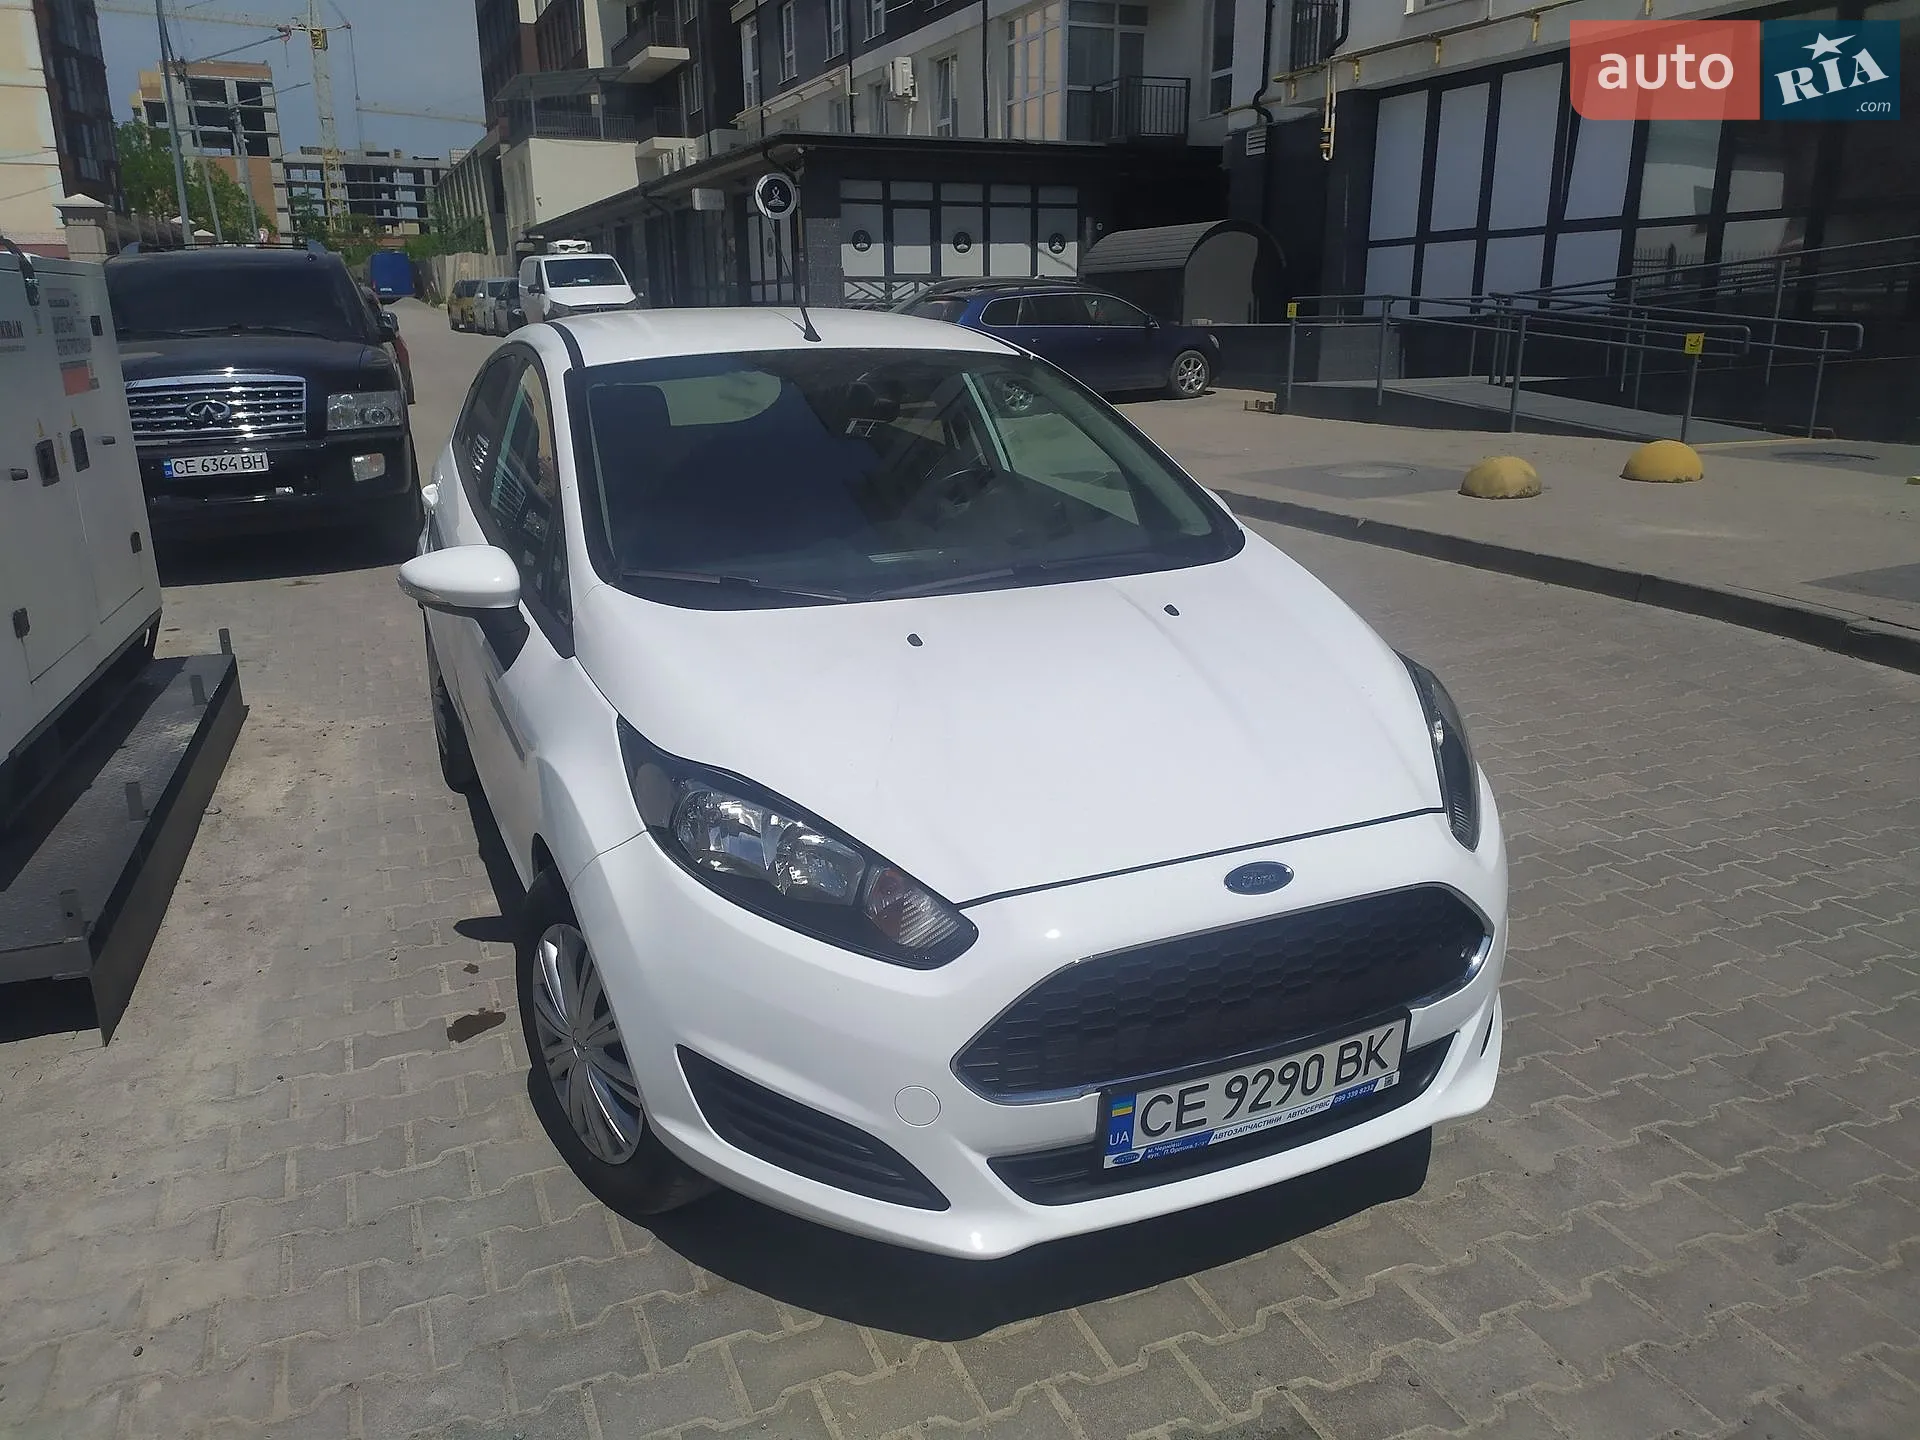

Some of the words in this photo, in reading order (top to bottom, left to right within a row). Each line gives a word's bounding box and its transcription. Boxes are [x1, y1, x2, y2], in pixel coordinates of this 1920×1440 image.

[173, 459, 197, 475] CE
[201, 456, 238, 473] 6364
[240, 454, 265, 470] BH
[1140, 1083, 1210, 1137] CE
[1222, 1053, 1325, 1121] 9290
[1334, 1027, 1394, 1087] BK
[1109, 1130, 1130, 1146] UA
